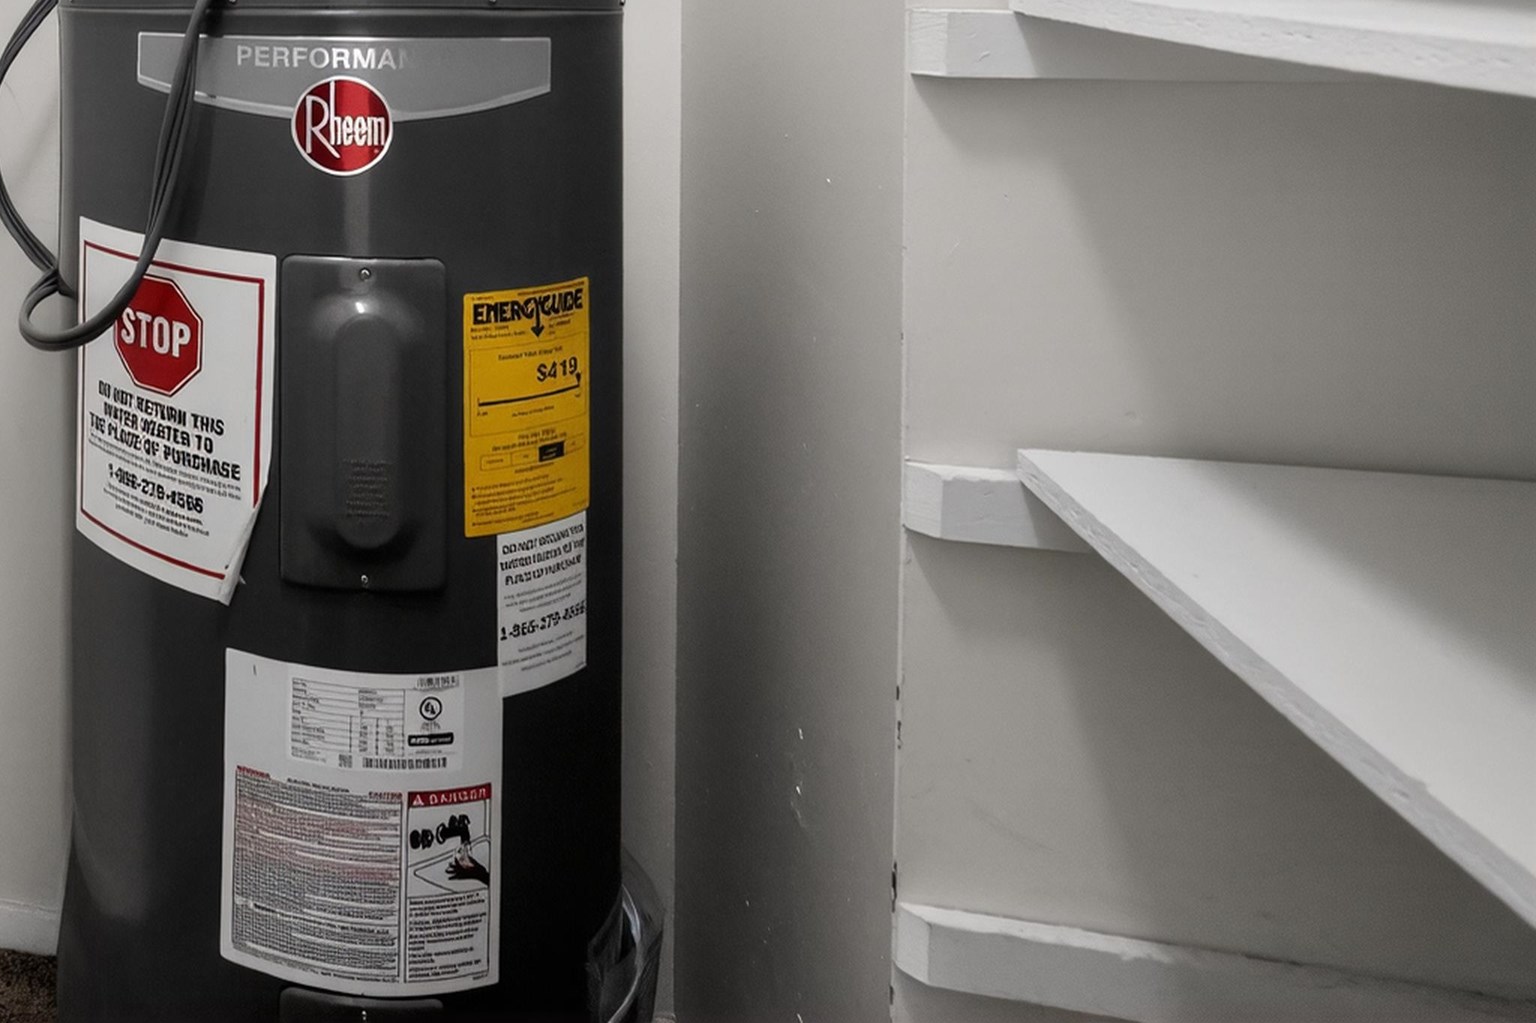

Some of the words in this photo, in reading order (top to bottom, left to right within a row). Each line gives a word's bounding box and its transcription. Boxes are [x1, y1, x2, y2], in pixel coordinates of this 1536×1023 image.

[305, 79, 386, 159] Rheem
[120, 307, 192, 358] STOP
[136, 395, 187, 427] RETURN
[191, 412, 226, 436] THIS
[143, 437, 160, 457] OF
[163, 445, 242, 481] PURCHASE
[195, 434, 215, 455] TO
